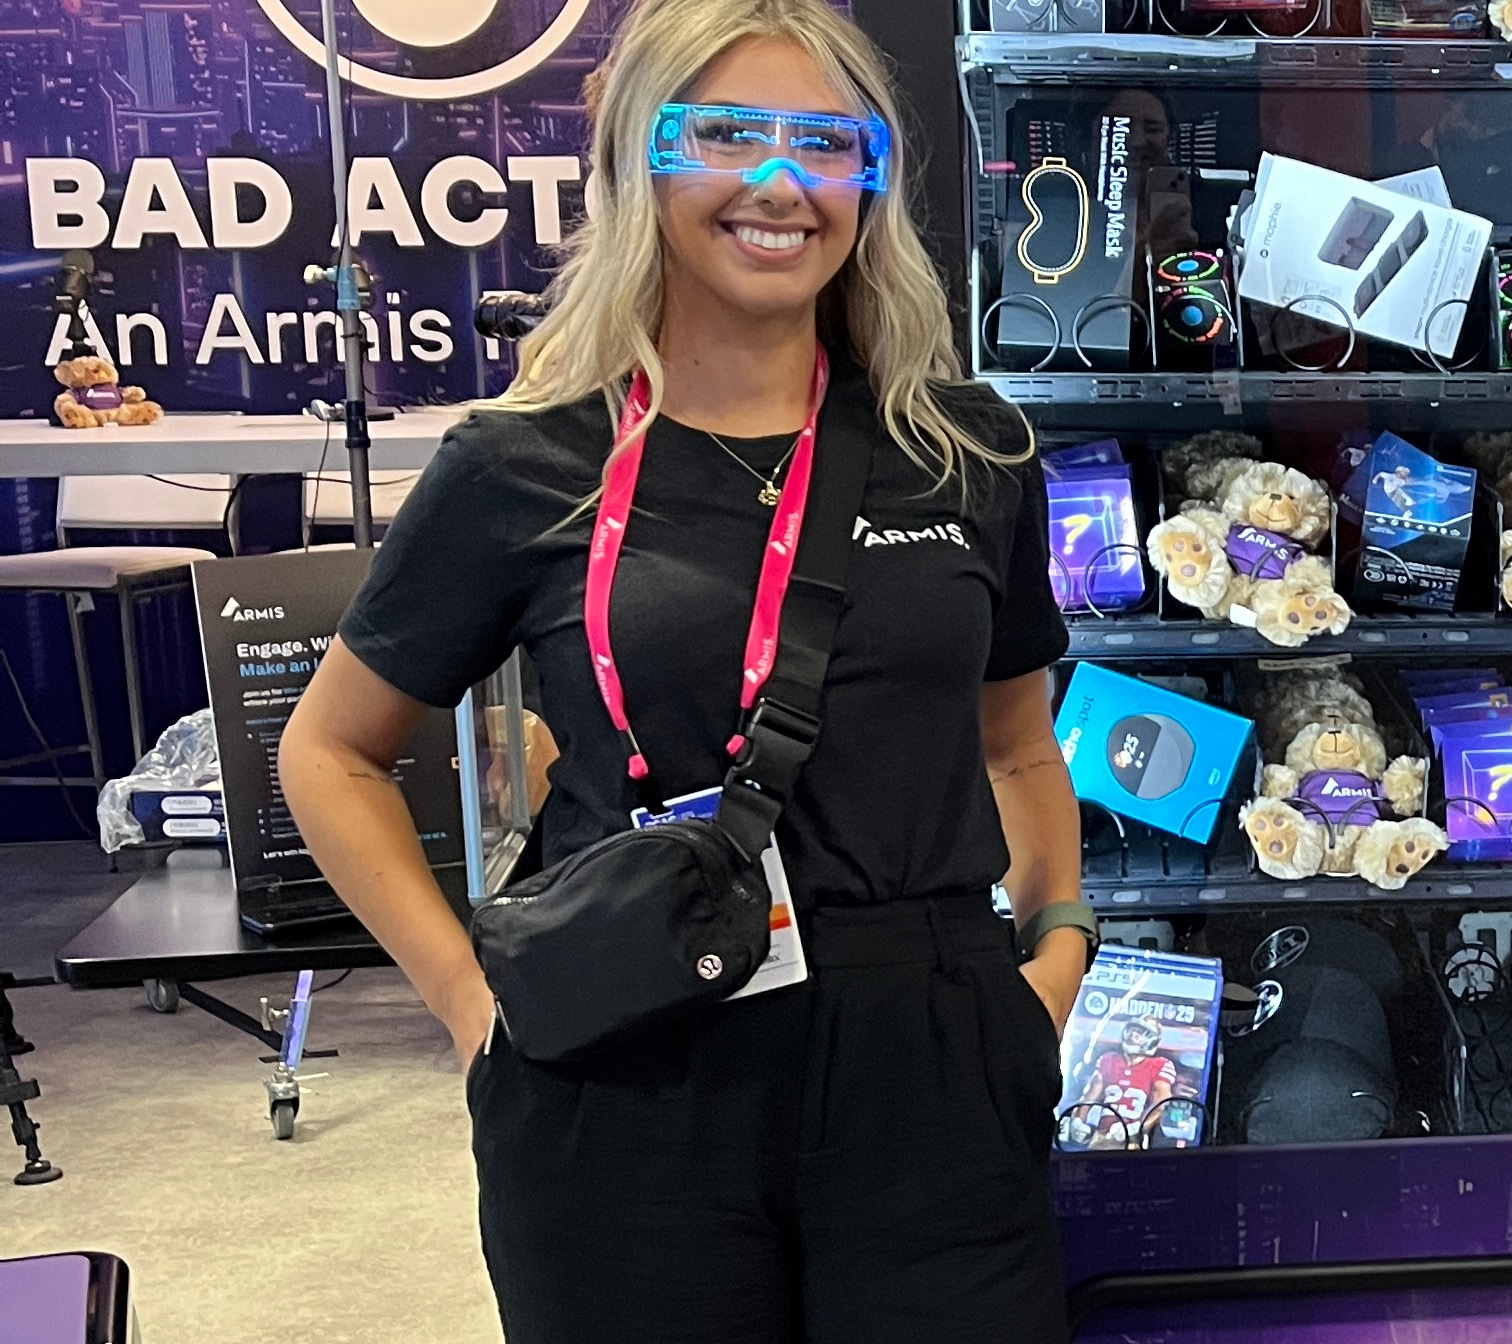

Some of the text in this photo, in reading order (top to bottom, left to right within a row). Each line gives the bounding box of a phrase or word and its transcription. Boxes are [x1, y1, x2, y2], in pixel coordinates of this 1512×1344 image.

[1111, 116, 1131, 165] Music
[25, 155, 600, 250] BAD ACT
[1104, 167, 1128, 211] Sleep
[1104, 212, 1126, 258] Mask
[233, 606, 285, 622] ARMIS
[236, 641, 309, 659] Engage.
[239, 662, 286, 678] Make
[289, 660, 311, 673] an
[756, 638, 775, 676] ARMIS
